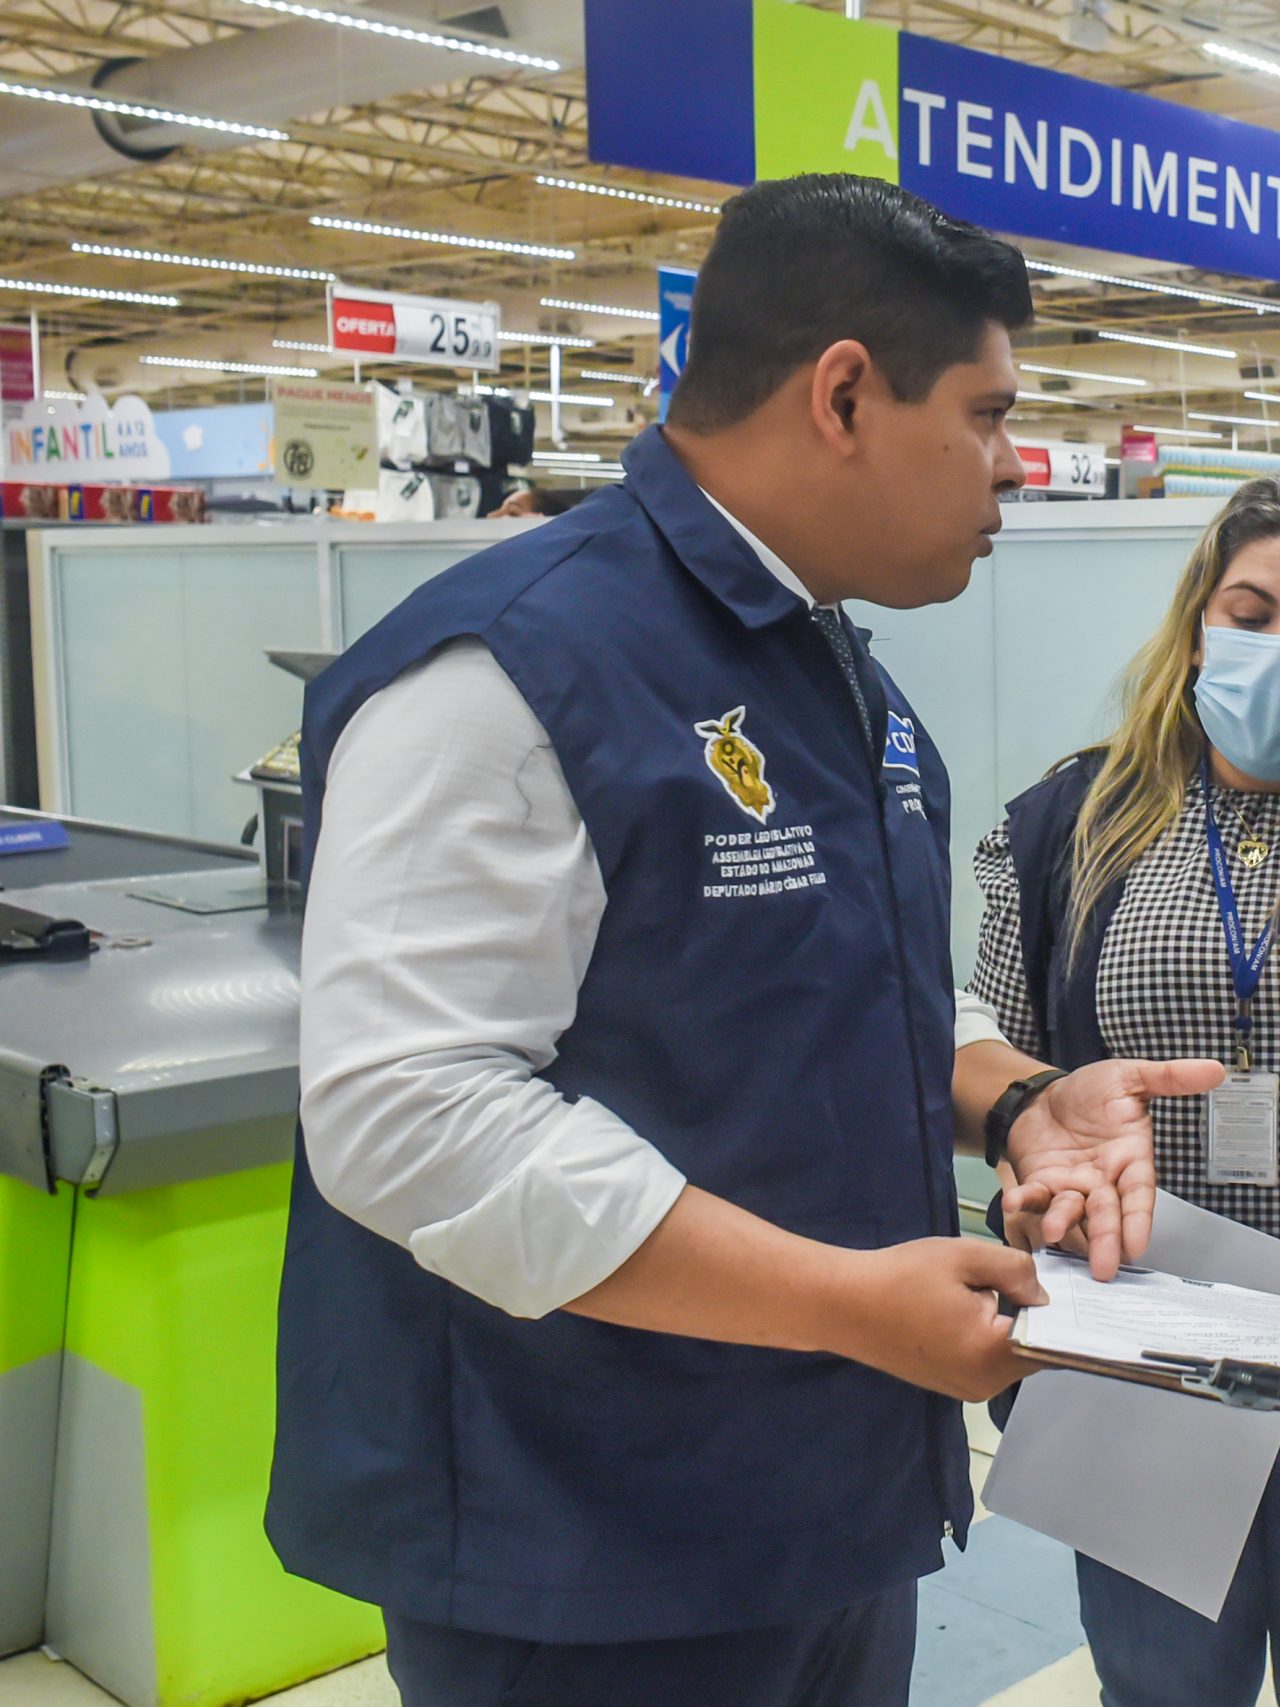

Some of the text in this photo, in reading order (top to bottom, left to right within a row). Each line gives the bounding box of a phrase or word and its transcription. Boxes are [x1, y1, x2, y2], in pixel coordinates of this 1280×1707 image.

[335, 316, 396, 338] OFERTA
[10, 421, 114, 465] INFANTIL
[704, 825, 813, 847] PODER LEGISLATIVO
[721, 863, 758, 878] ESTADO
[703, 884, 757, 898] DEPUTADO
[1226, 911, 1241, 955] PROCON/AM
